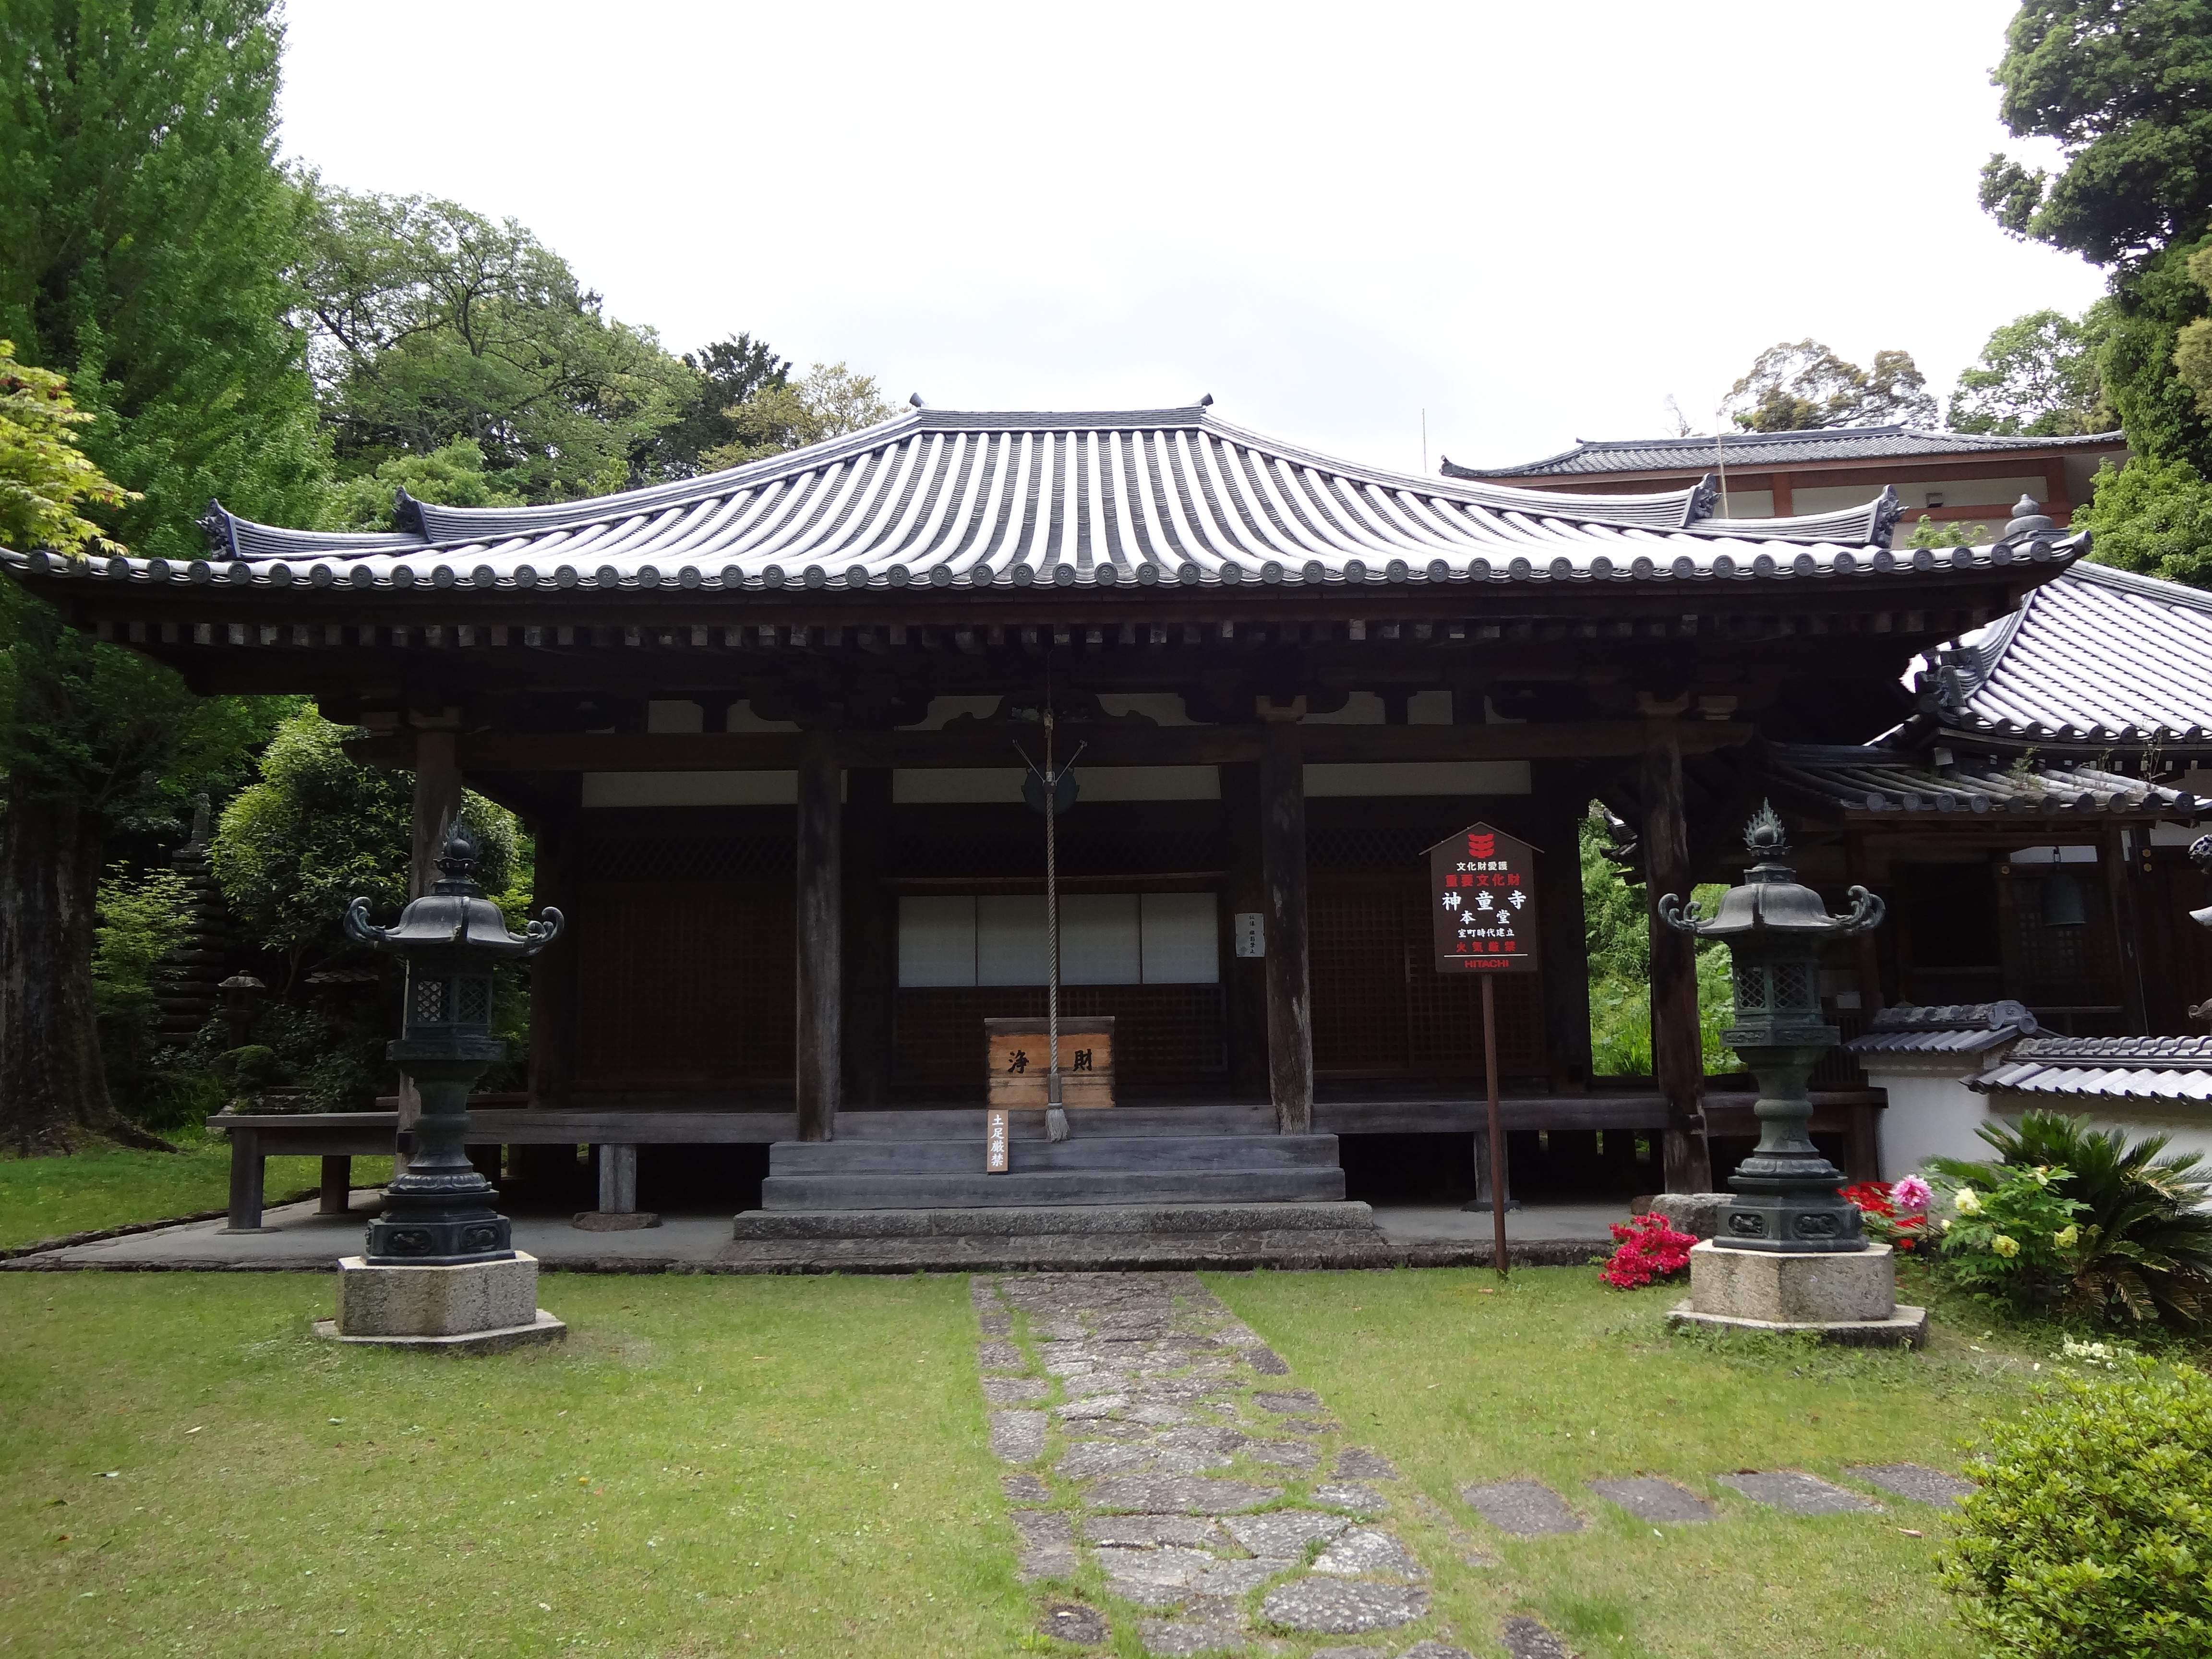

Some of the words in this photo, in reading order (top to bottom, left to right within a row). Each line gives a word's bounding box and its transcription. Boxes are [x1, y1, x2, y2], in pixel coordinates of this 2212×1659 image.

[1456, 862, 1508, 871] 文化財愛護
[1445, 874, 1520, 887] 重要文化財
[1442, 890, 1526, 911] 神童寺
[1460, 909, 1510, 924] 本堂
[1458, 928, 1515, 938] 室町時代建立
[1456, 941, 1516, 952] 火気厳禁
[1465, 960, 1509, 968] HITACHI
[990, 1114, 1005, 1167] 土足厳禁
